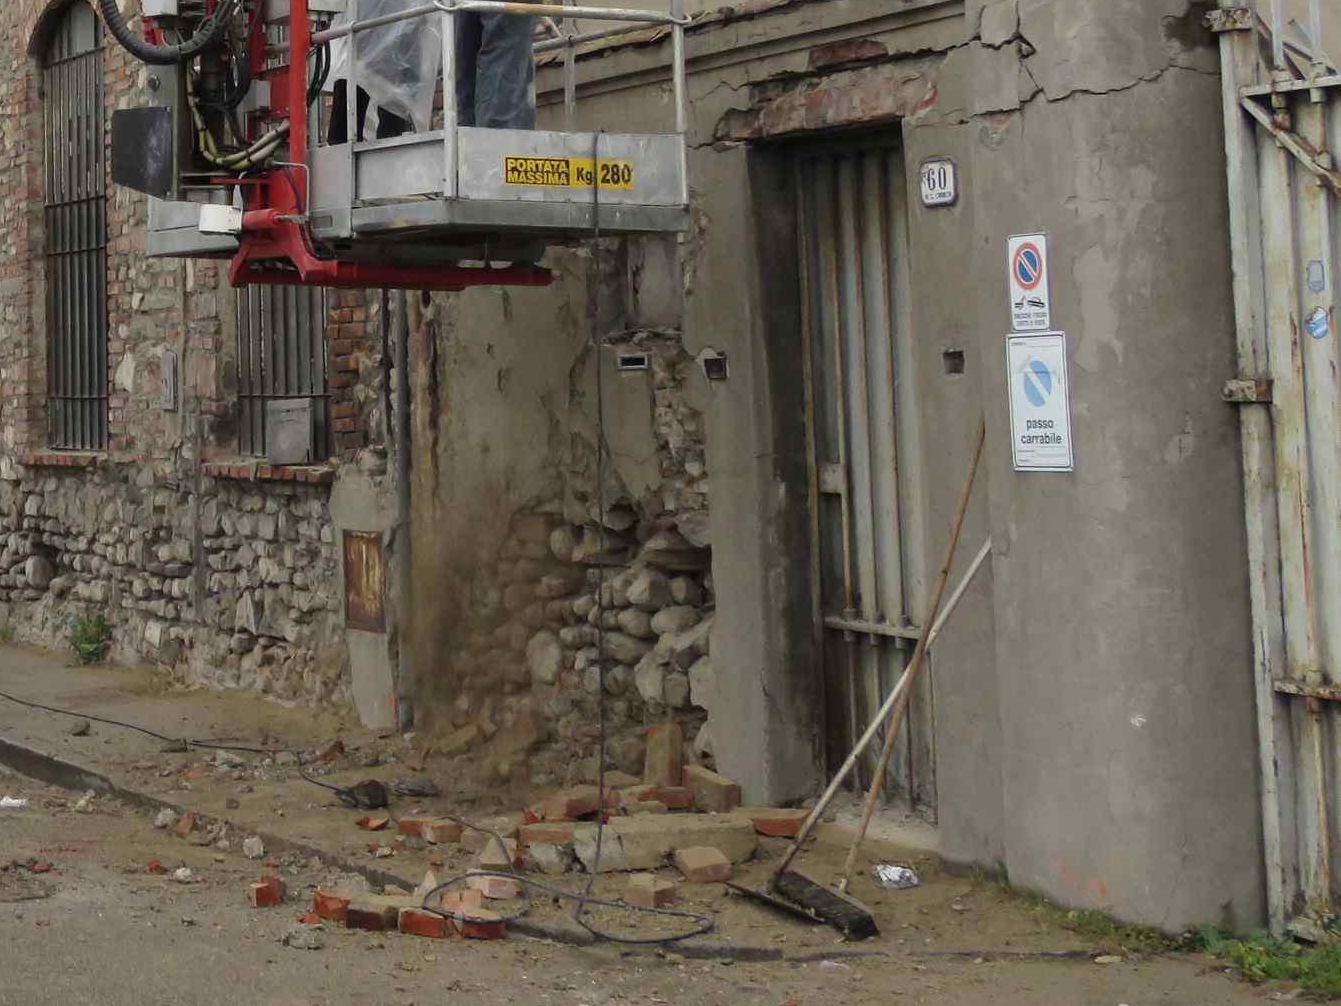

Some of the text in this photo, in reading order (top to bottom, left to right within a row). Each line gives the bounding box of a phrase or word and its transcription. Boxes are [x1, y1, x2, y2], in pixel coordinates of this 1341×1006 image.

[507, 159, 567, 173] PORTATA
[507, 171, 568, 185] MASSIMA
[601, 163, 632, 185] 280
[928, 167, 947, 191] 60
[1026, 419, 1054, 432] passo
[1021, 433, 1062, 444] carrabile
